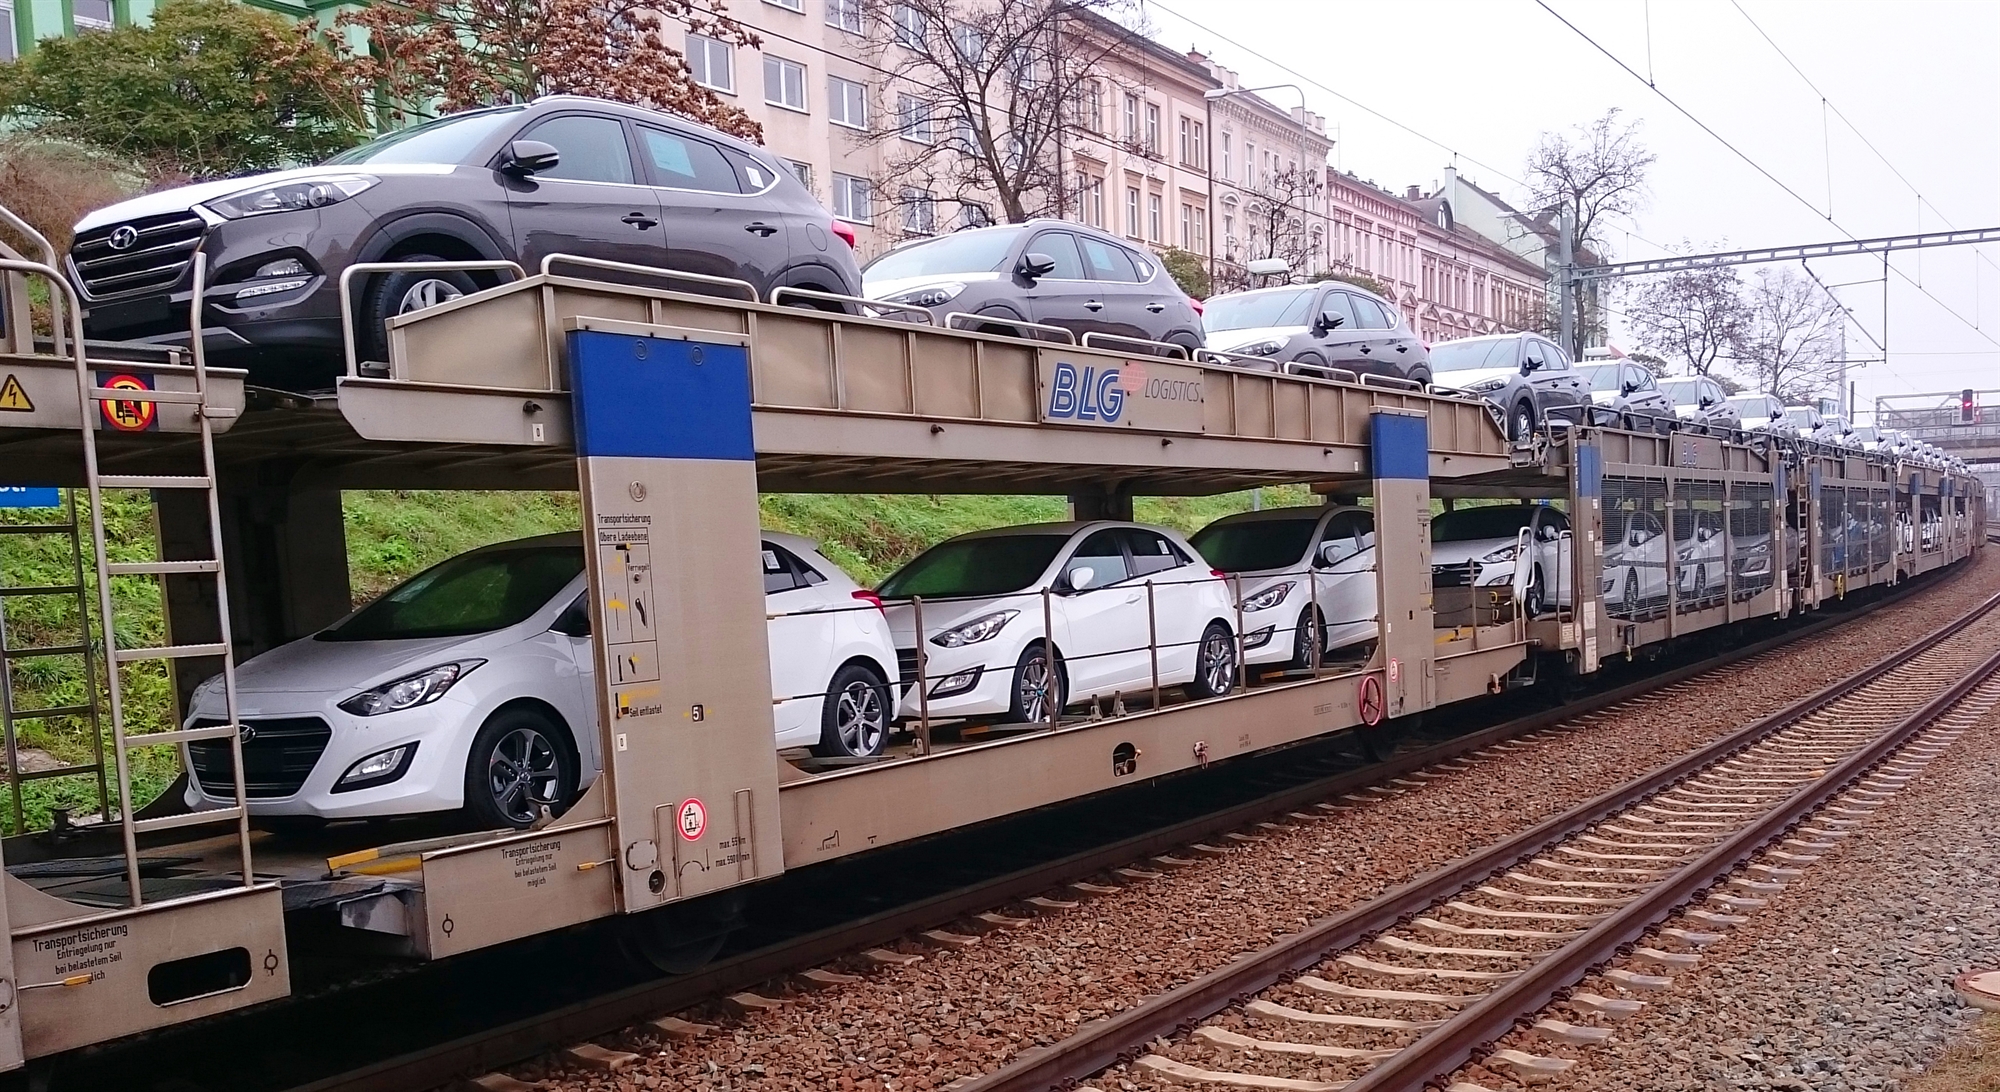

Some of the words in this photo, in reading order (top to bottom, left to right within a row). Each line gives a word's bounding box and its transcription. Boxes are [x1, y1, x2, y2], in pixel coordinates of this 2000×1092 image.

[1048, 362, 1125, 423] BLG
[1144, 378, 1200, 402] LOGISTICS
[597, 513, 651, 526] Transportsicherung
[500, 841, 561, 859] Transportsicherung
[32, 924, 128, 952] Transportsicherung
[56, 943, 104, 960] Entriegelung
[104, 940, 117, 950] nur
[55, 963, 67, 975] bei
[67, 957, 109, 973] belastetem
[109, 951, 123, 963] Seil
